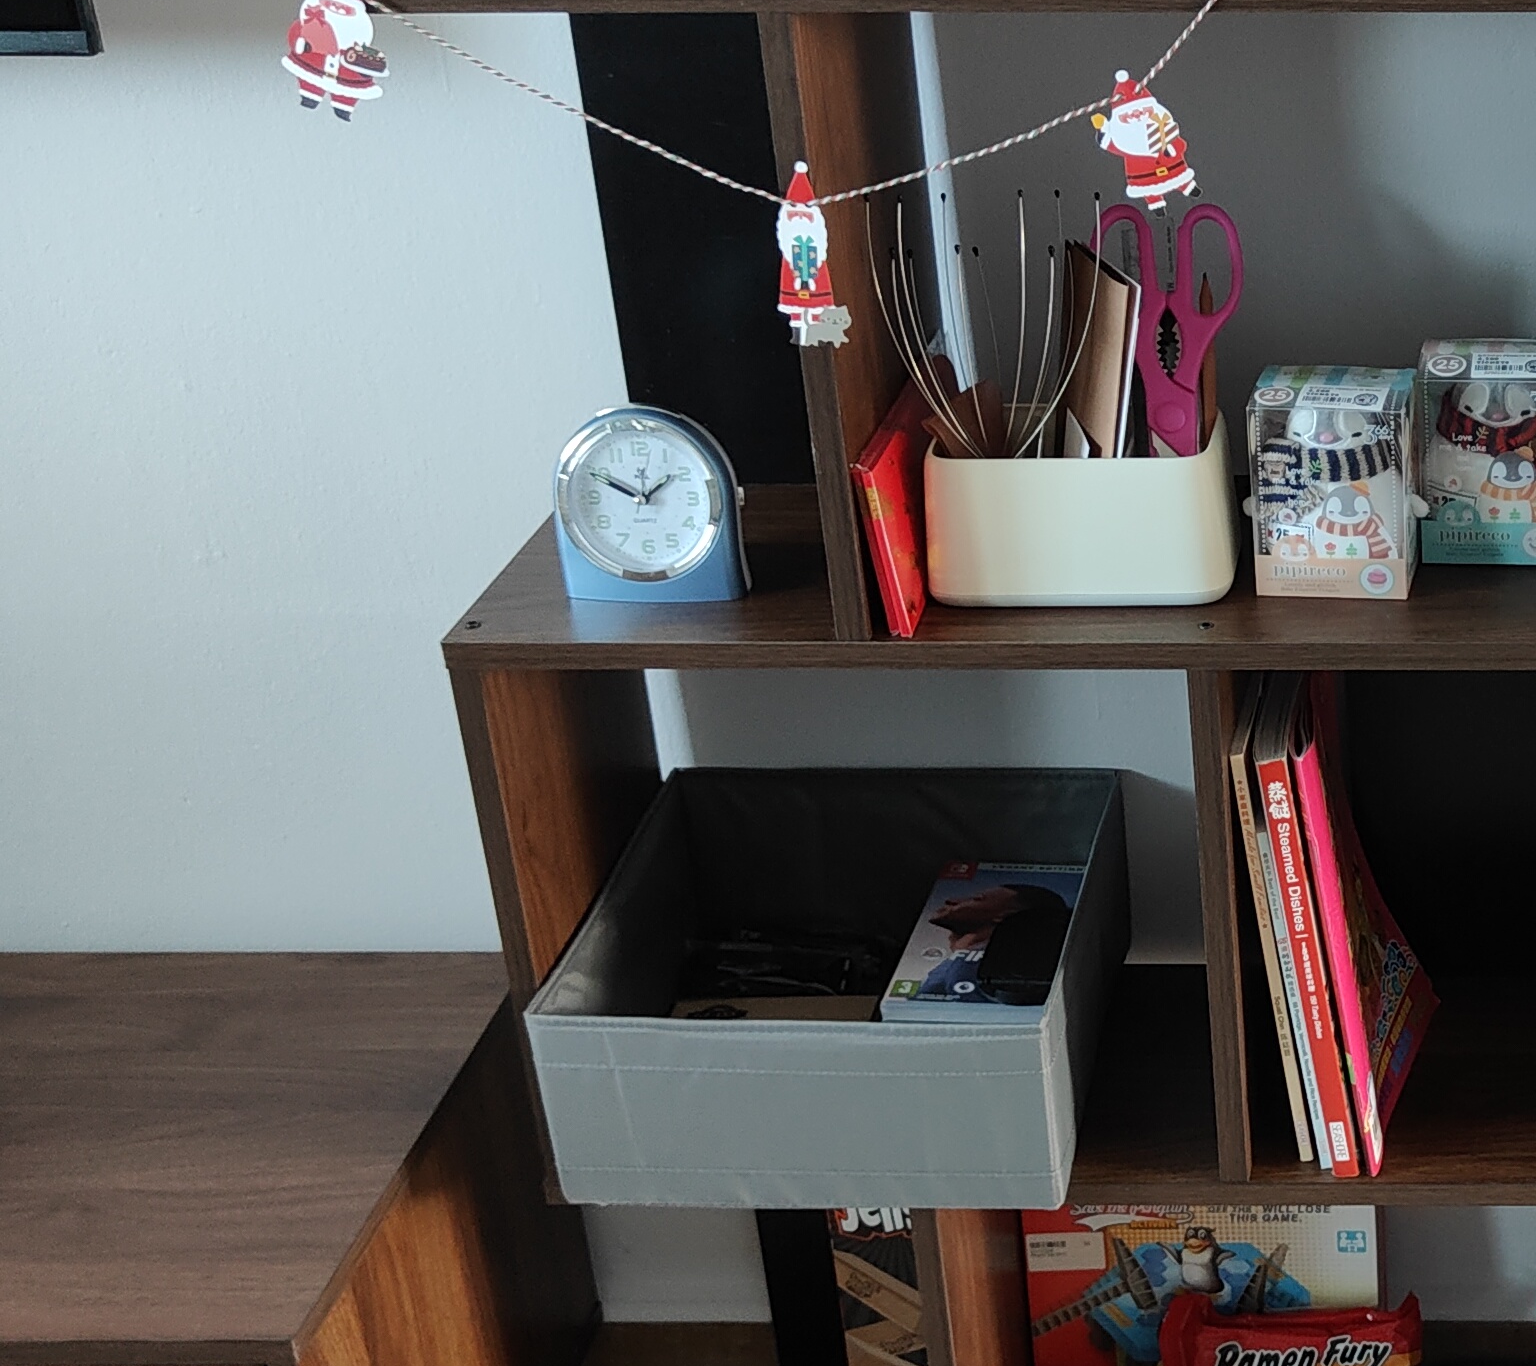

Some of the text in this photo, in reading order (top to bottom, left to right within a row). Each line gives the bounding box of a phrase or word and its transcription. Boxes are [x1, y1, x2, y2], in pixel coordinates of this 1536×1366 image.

[1435, 359, 1459, 370] 25
[1263, 390, 1287, 400] 25
[1452, 433, 1473, 442] Love
[609, 448, 624, 463] 11
[631, 441, 649, 456] 12
[662, 448, 668, 463] 1
[678, 466, 691, 482] 2
[588, 490, 602, 506] 9
[686, 491, 700, 506] 3
[598, 514, 612, 529] 8
[682, 516, 696, 530] 4
[616, 533, 630, 547] 7
[642, 539, 656, 554] 6
[666, 533, 680, 548] 5
[1276, 821, 1298, 883] Steamed
[1287, 885, 1307, 931] Dishes
[897, 982, 907, 993] 3
[1229, 1213, 1259, 1223] THIS
